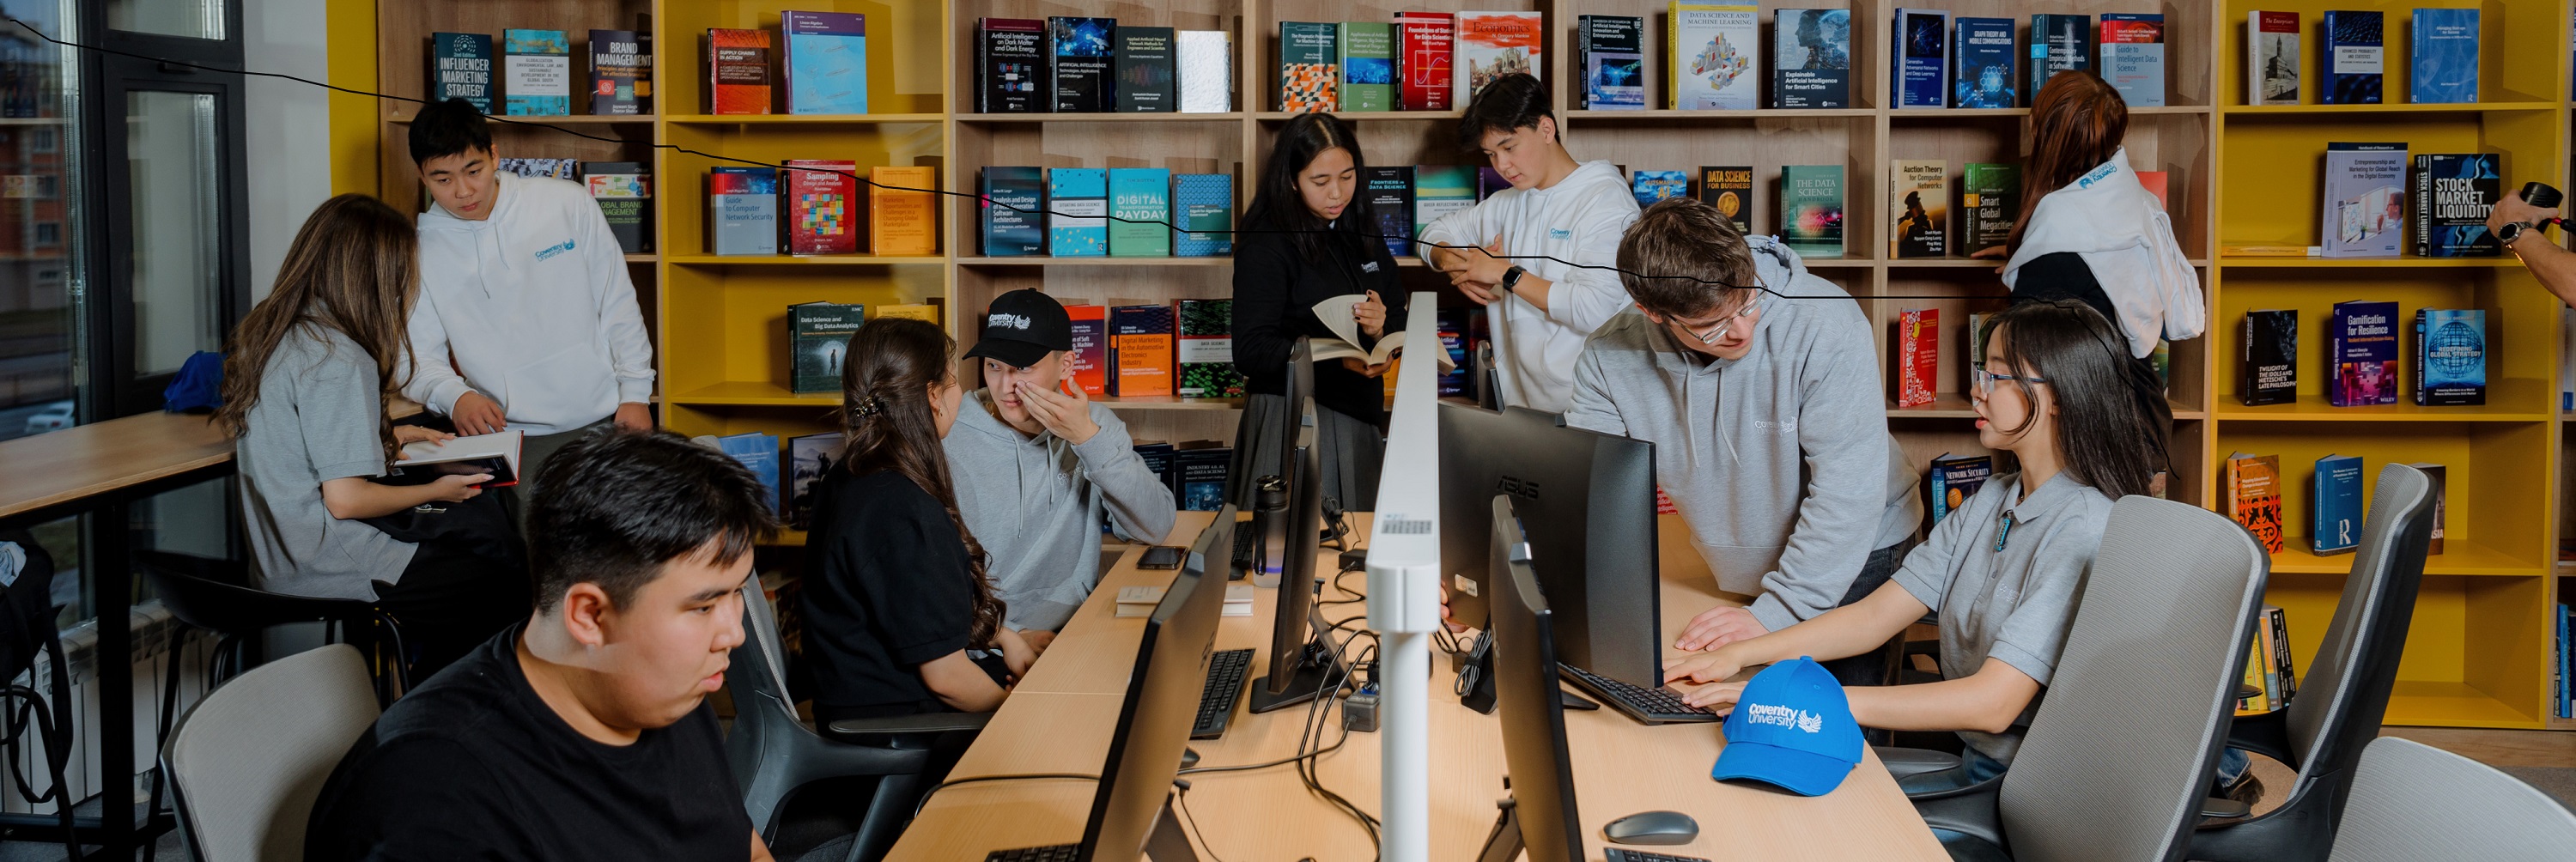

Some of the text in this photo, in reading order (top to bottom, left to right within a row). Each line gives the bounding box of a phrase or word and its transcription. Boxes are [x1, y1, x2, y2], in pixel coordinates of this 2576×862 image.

[1473, 21, 1530, 33] Economics
[1012, 33, 1040, 41] Intelligence
[611, 42, 638, 53] BRAND
[440, 58, 489, 71] INFLUENCER
[597, 53, 653, 67] MANAGEMENT
[2117, 55, 2144, 64] Intelligent
[2117, 64, 2137, 72] Science
[442, 71, 489, 84] MARKETING
[447, 84, 484, 96] STRATEGY
[2354, 159, 2387, 167] Entrepreneurship
[1924, 166, 1942, 174] Theory
[806, 172, 839, 182] Sampling
[1707, 170, 1752, 183] DATA SCIENCE
[1917, 174, 1942, 183] Computer
[2436, 178, 2474, 191] STOCK
[1657, 188, 1670, 198] AI
[1798, 188, 1833, 197] SCIENCE
[2436, 191, 2484, 204] MARKET
[993, 197, 1011, 205] Analysis
[1116, 195, 1165, 205] DIGITAL
[1980, 197, 2000, 206] Smart
[732, 204, 760, 214] Computer
[993, 209, 1013, 218] Software
[1980, 208, 2001, 219] Global
[2436, 204, 2494, 218] LIQUIDITY
[750, 213, 774, 222] Security
[1115, 209, 1167, 221] PAYDAY
[1980, 220, 2014, 233] Megacities
[2421, 216, 2429, 244] LIQUIDITY
[535, 243, 562, 259] Coventry
[988, 313, 1016, 324] Coventry
[2348, 314, 2386, 326] Gamification
[2348, 325, 2389, 336] for Resilience
[1121, 337, 1163, 345] Digital Marketing
[1121, 359, 1142, 367] Industry
[1946, 468, 1990, 480] NETWORK SECURITY
[1497, 475, 1540, 499] ASUS
[1748, 702, 1798, 720] Coventry
[1748, 713, 1796, 730] University
